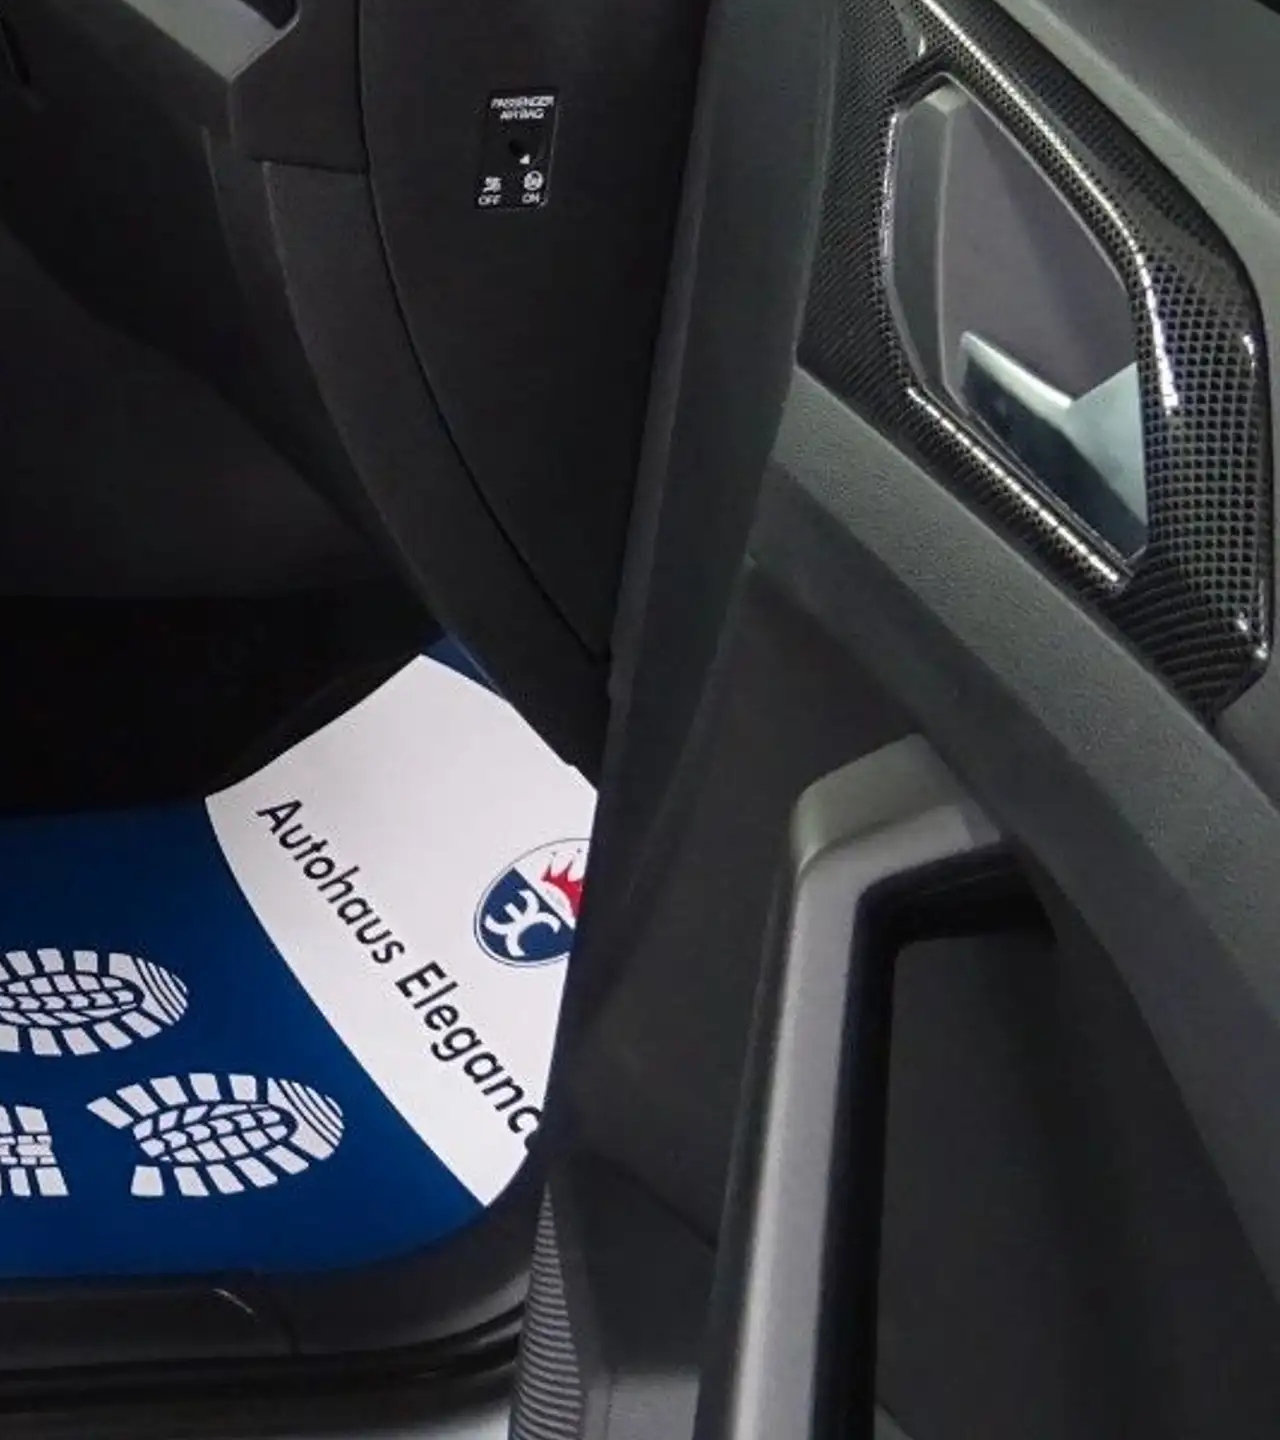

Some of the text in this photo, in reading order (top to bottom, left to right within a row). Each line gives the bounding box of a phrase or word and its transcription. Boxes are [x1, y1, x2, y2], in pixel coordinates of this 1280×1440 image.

[490, 96, 555, 110] PASSENGER
[478, 192, 540, 205] OFF ON
[255, 799, 543, 1151] Autohaus Eleganc
